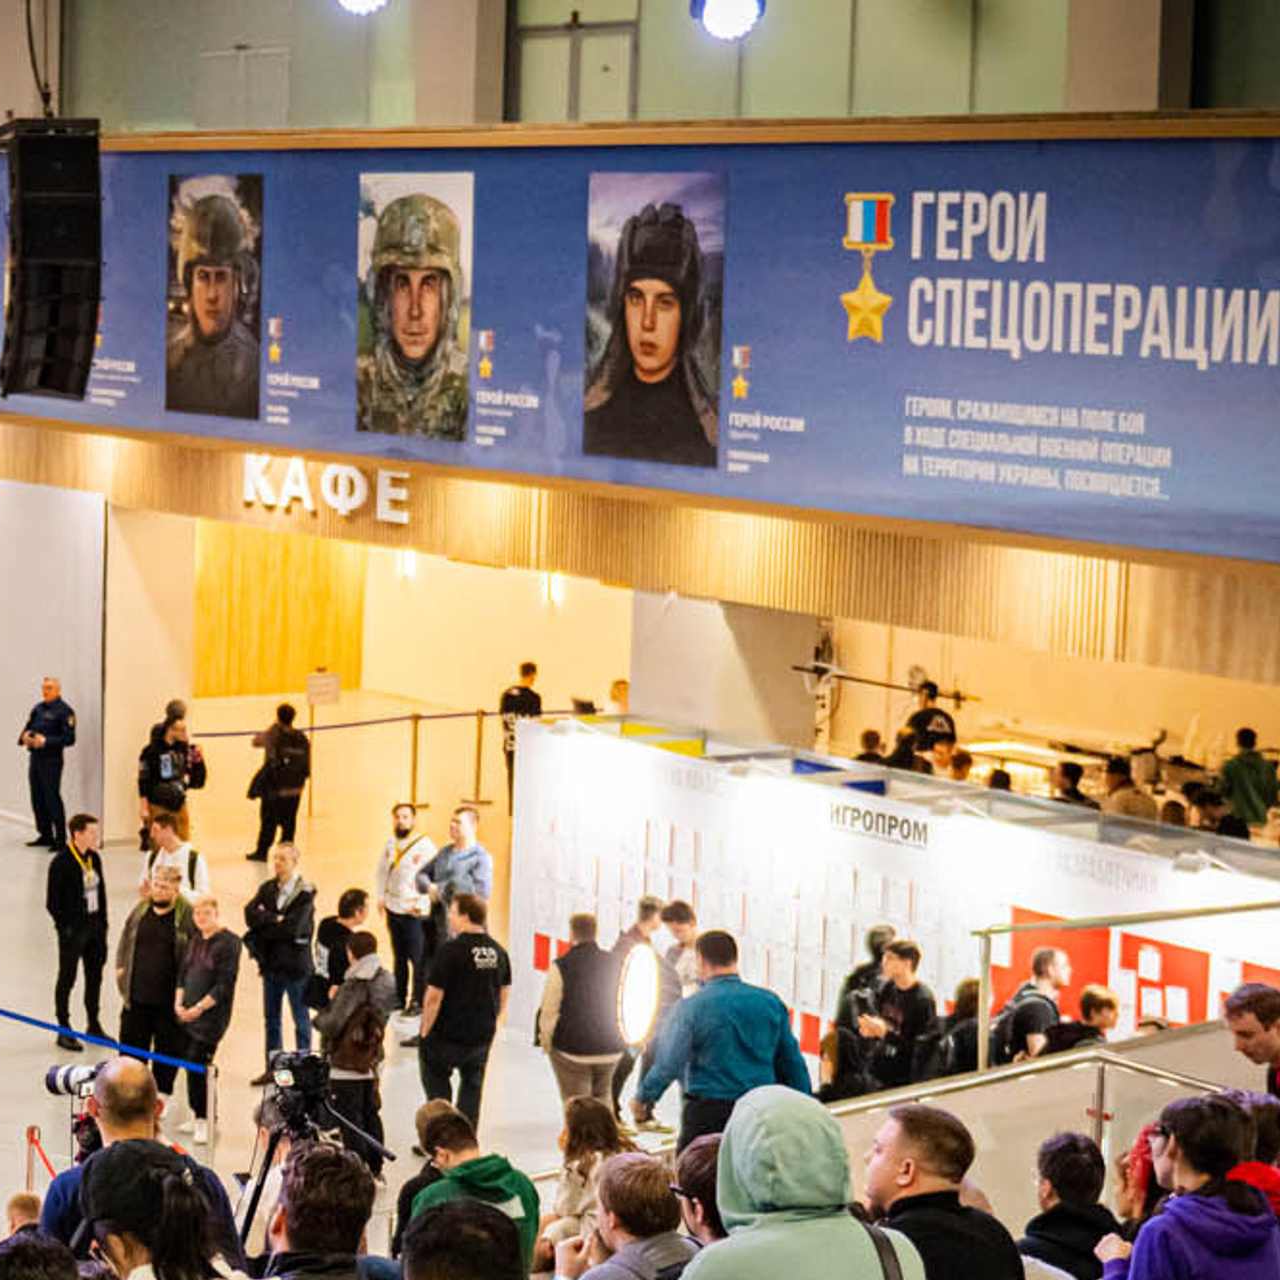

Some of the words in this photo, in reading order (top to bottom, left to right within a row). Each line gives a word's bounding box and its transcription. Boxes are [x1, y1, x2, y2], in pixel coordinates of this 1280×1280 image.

[910, 190, 1048, 263] ГЕРОИ
[906, 276, 1280, 370] СПЕЦОПЕРАЦИИ
[243, 453, 411, 524] КАФЕ
[830, 802, 928, 845] ИГРОПРОМ
